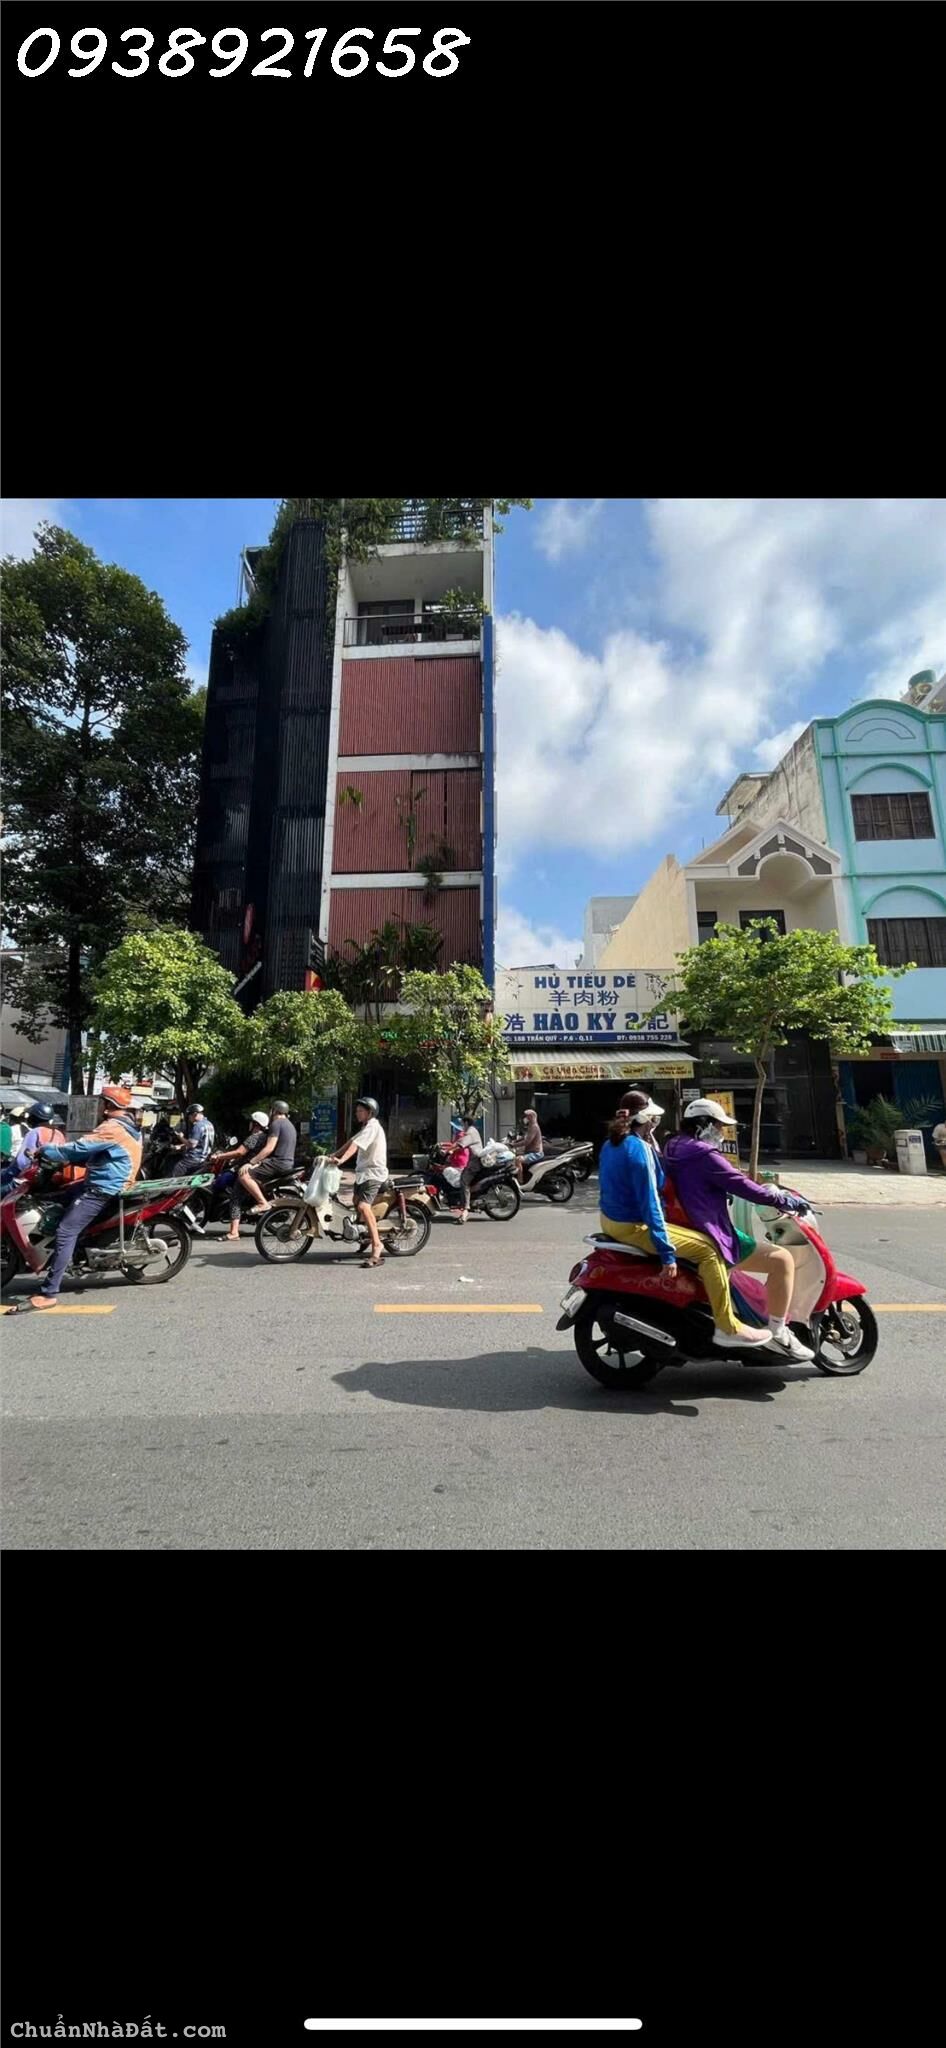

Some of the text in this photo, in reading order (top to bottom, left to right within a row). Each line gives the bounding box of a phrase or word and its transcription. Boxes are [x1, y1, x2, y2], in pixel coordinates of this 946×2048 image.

[534, 972, 561, 988] HỦ
[548, 990, 620, 1006] 羊肉粉
[504, 1013, 526, 1032] 浩
[533, 1008, 579, 1031] HÀO
[587, 1008, 617, 1031] KÝ
